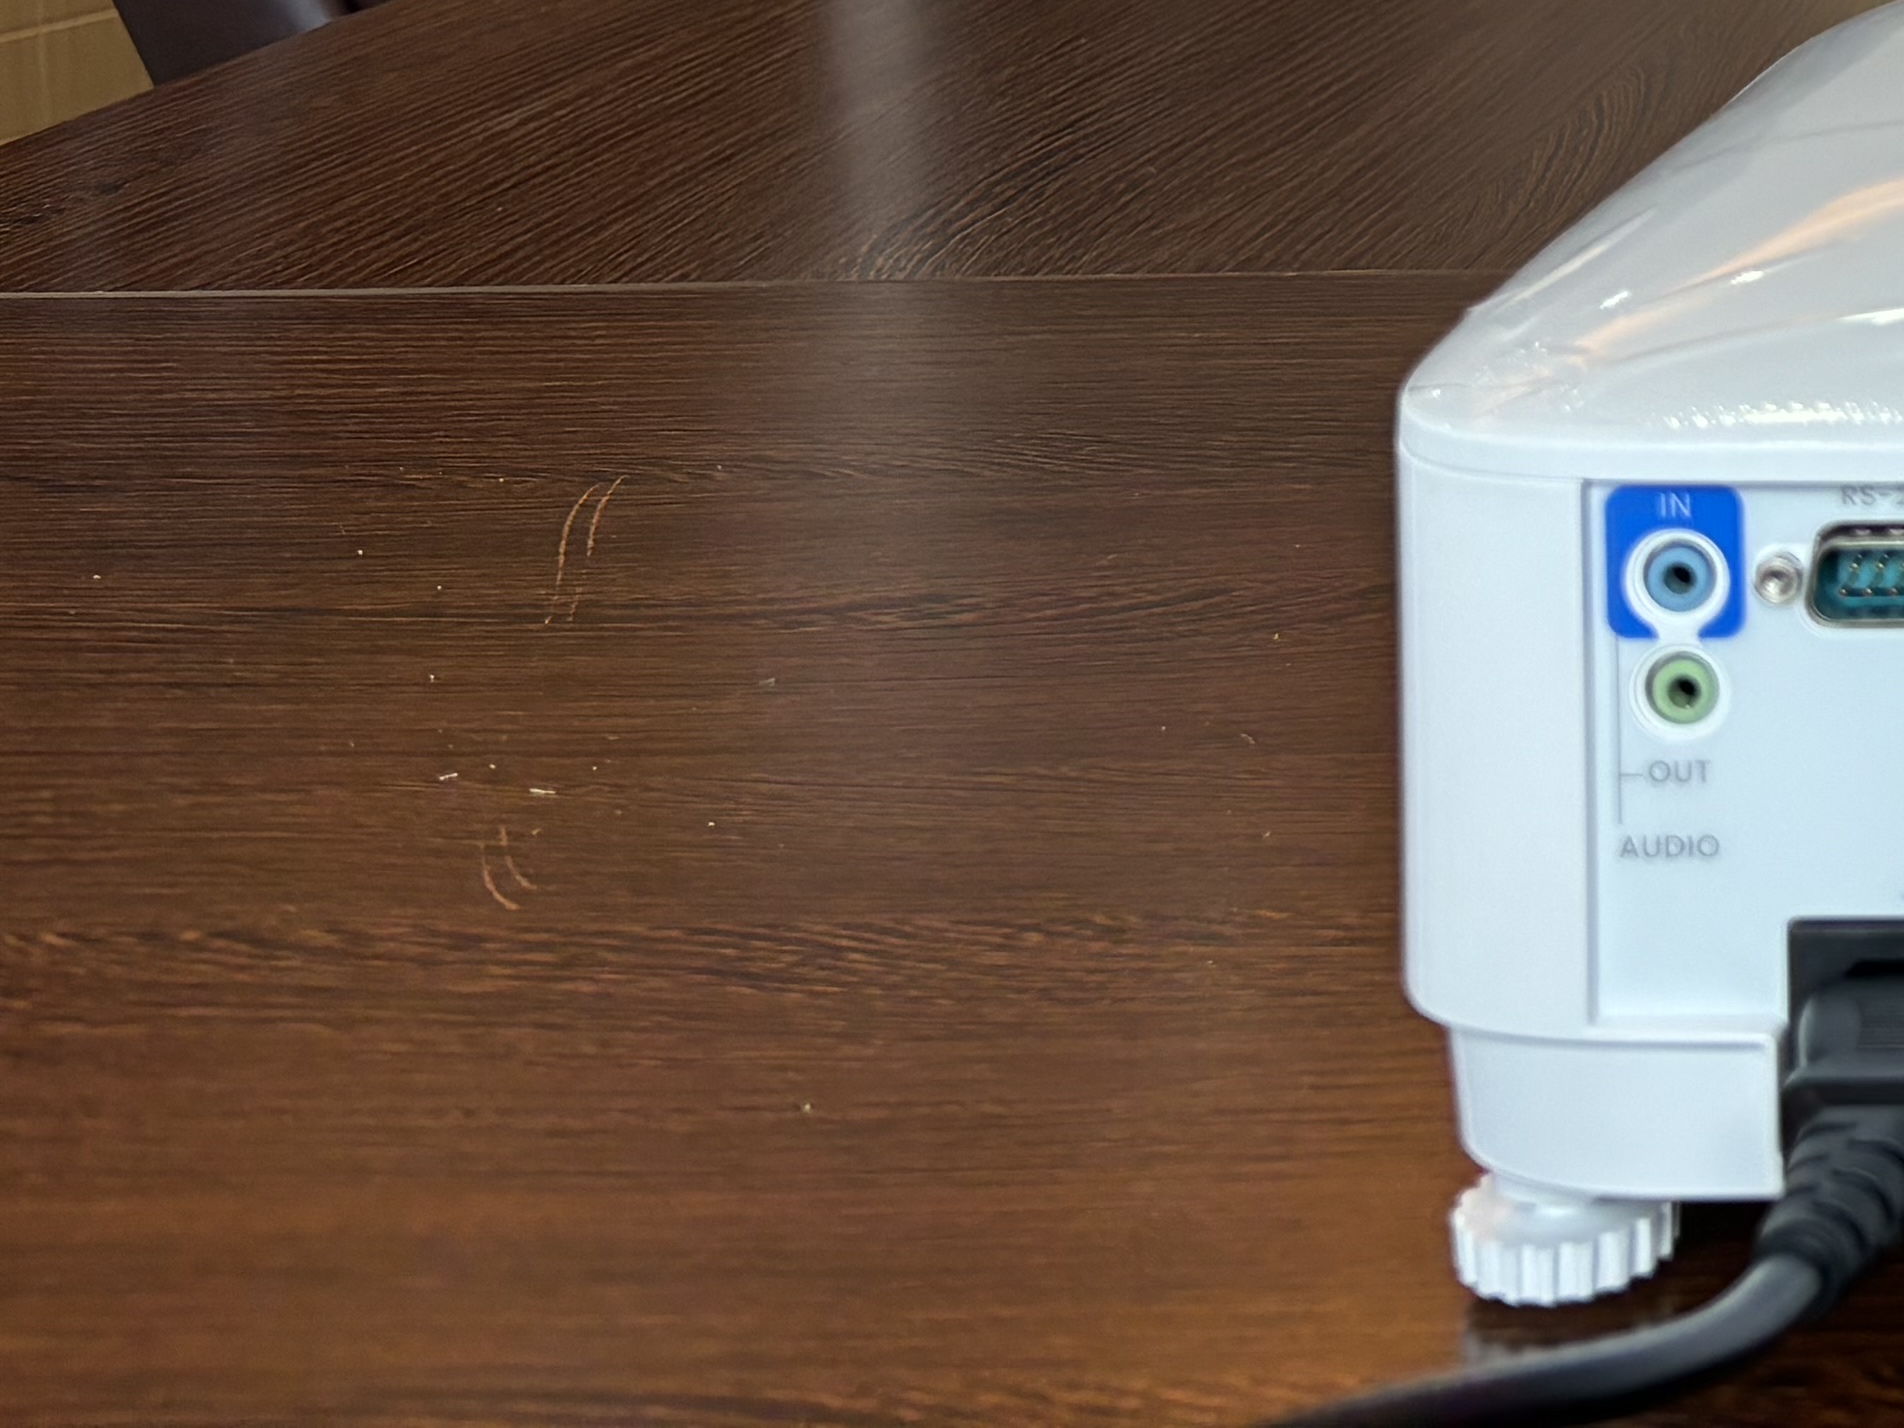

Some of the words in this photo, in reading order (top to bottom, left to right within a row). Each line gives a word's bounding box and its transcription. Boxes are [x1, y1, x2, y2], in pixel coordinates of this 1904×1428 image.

[1658, 493, 1692, 518] IN
[1648, 759, 1711, 784] OUT
[1619, 834, 1721, 859] AUDIO
